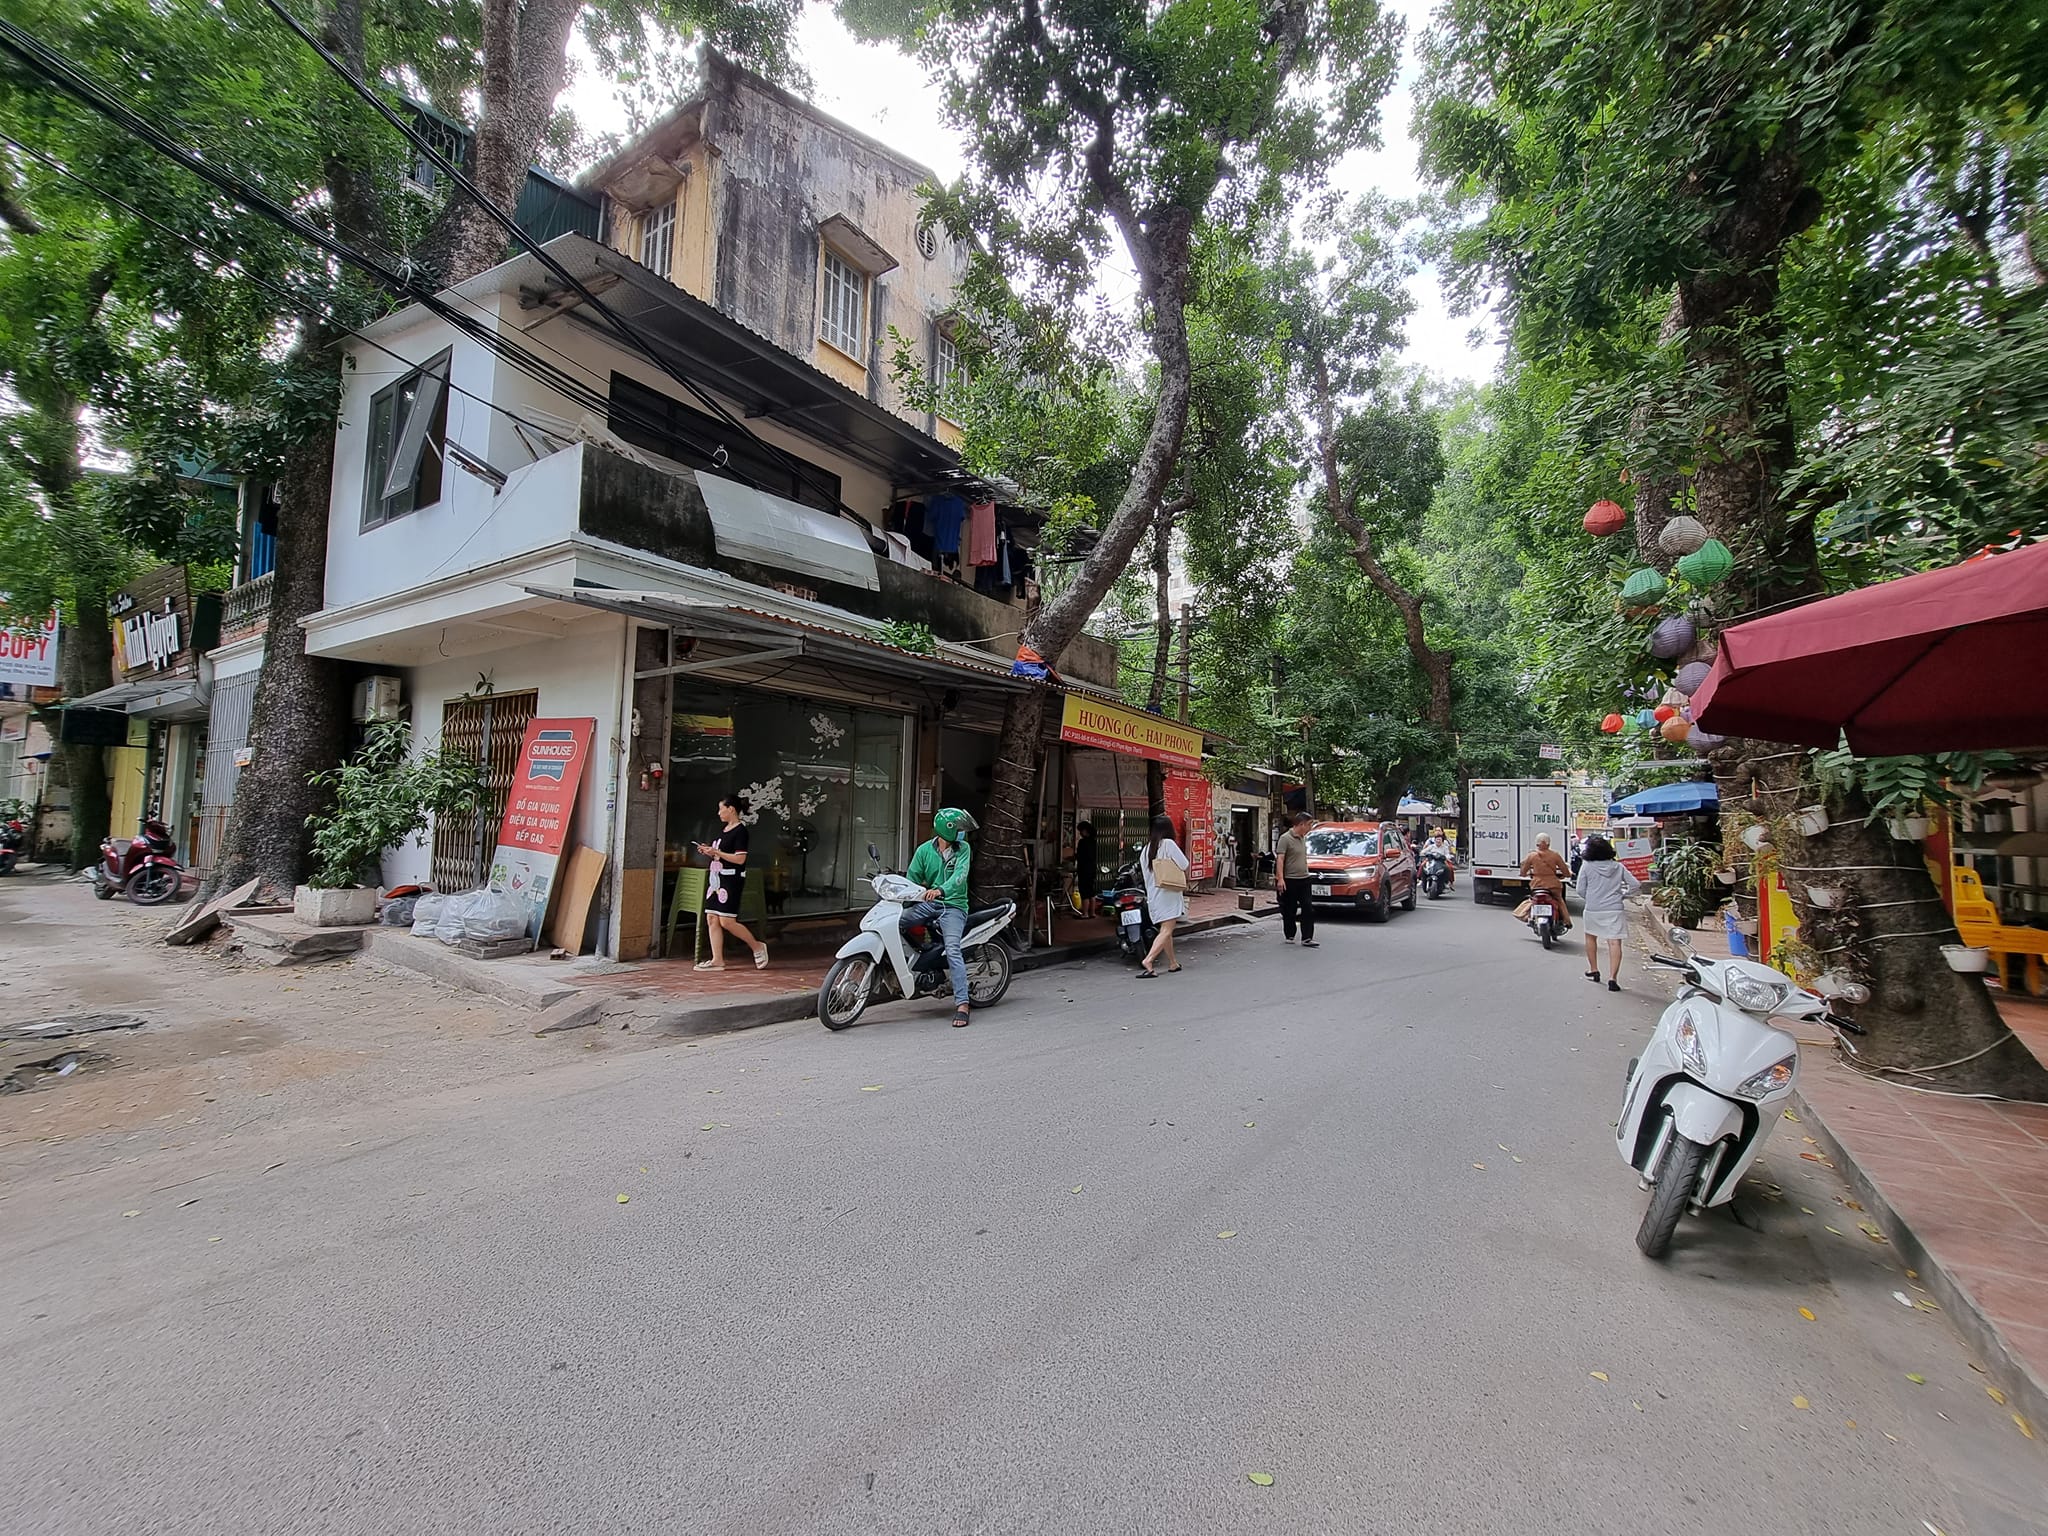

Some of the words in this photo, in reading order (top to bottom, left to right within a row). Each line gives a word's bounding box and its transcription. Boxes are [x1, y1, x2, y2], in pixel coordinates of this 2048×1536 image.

[0, 632, 48, 661] COPY
[532, 745, 573, 756] SUNHOUSE
[527, 801, 539, 811] GIA
[540, 803, 560, 814] DỤNG
[1541, 804, 1550, 812] XE
[526, 816, 538, 827] GIA
[539, 818, 560, 830] DỤNG
[515, 829, 529, 841] BẾP
[530, 833, 545, 844] GAS
